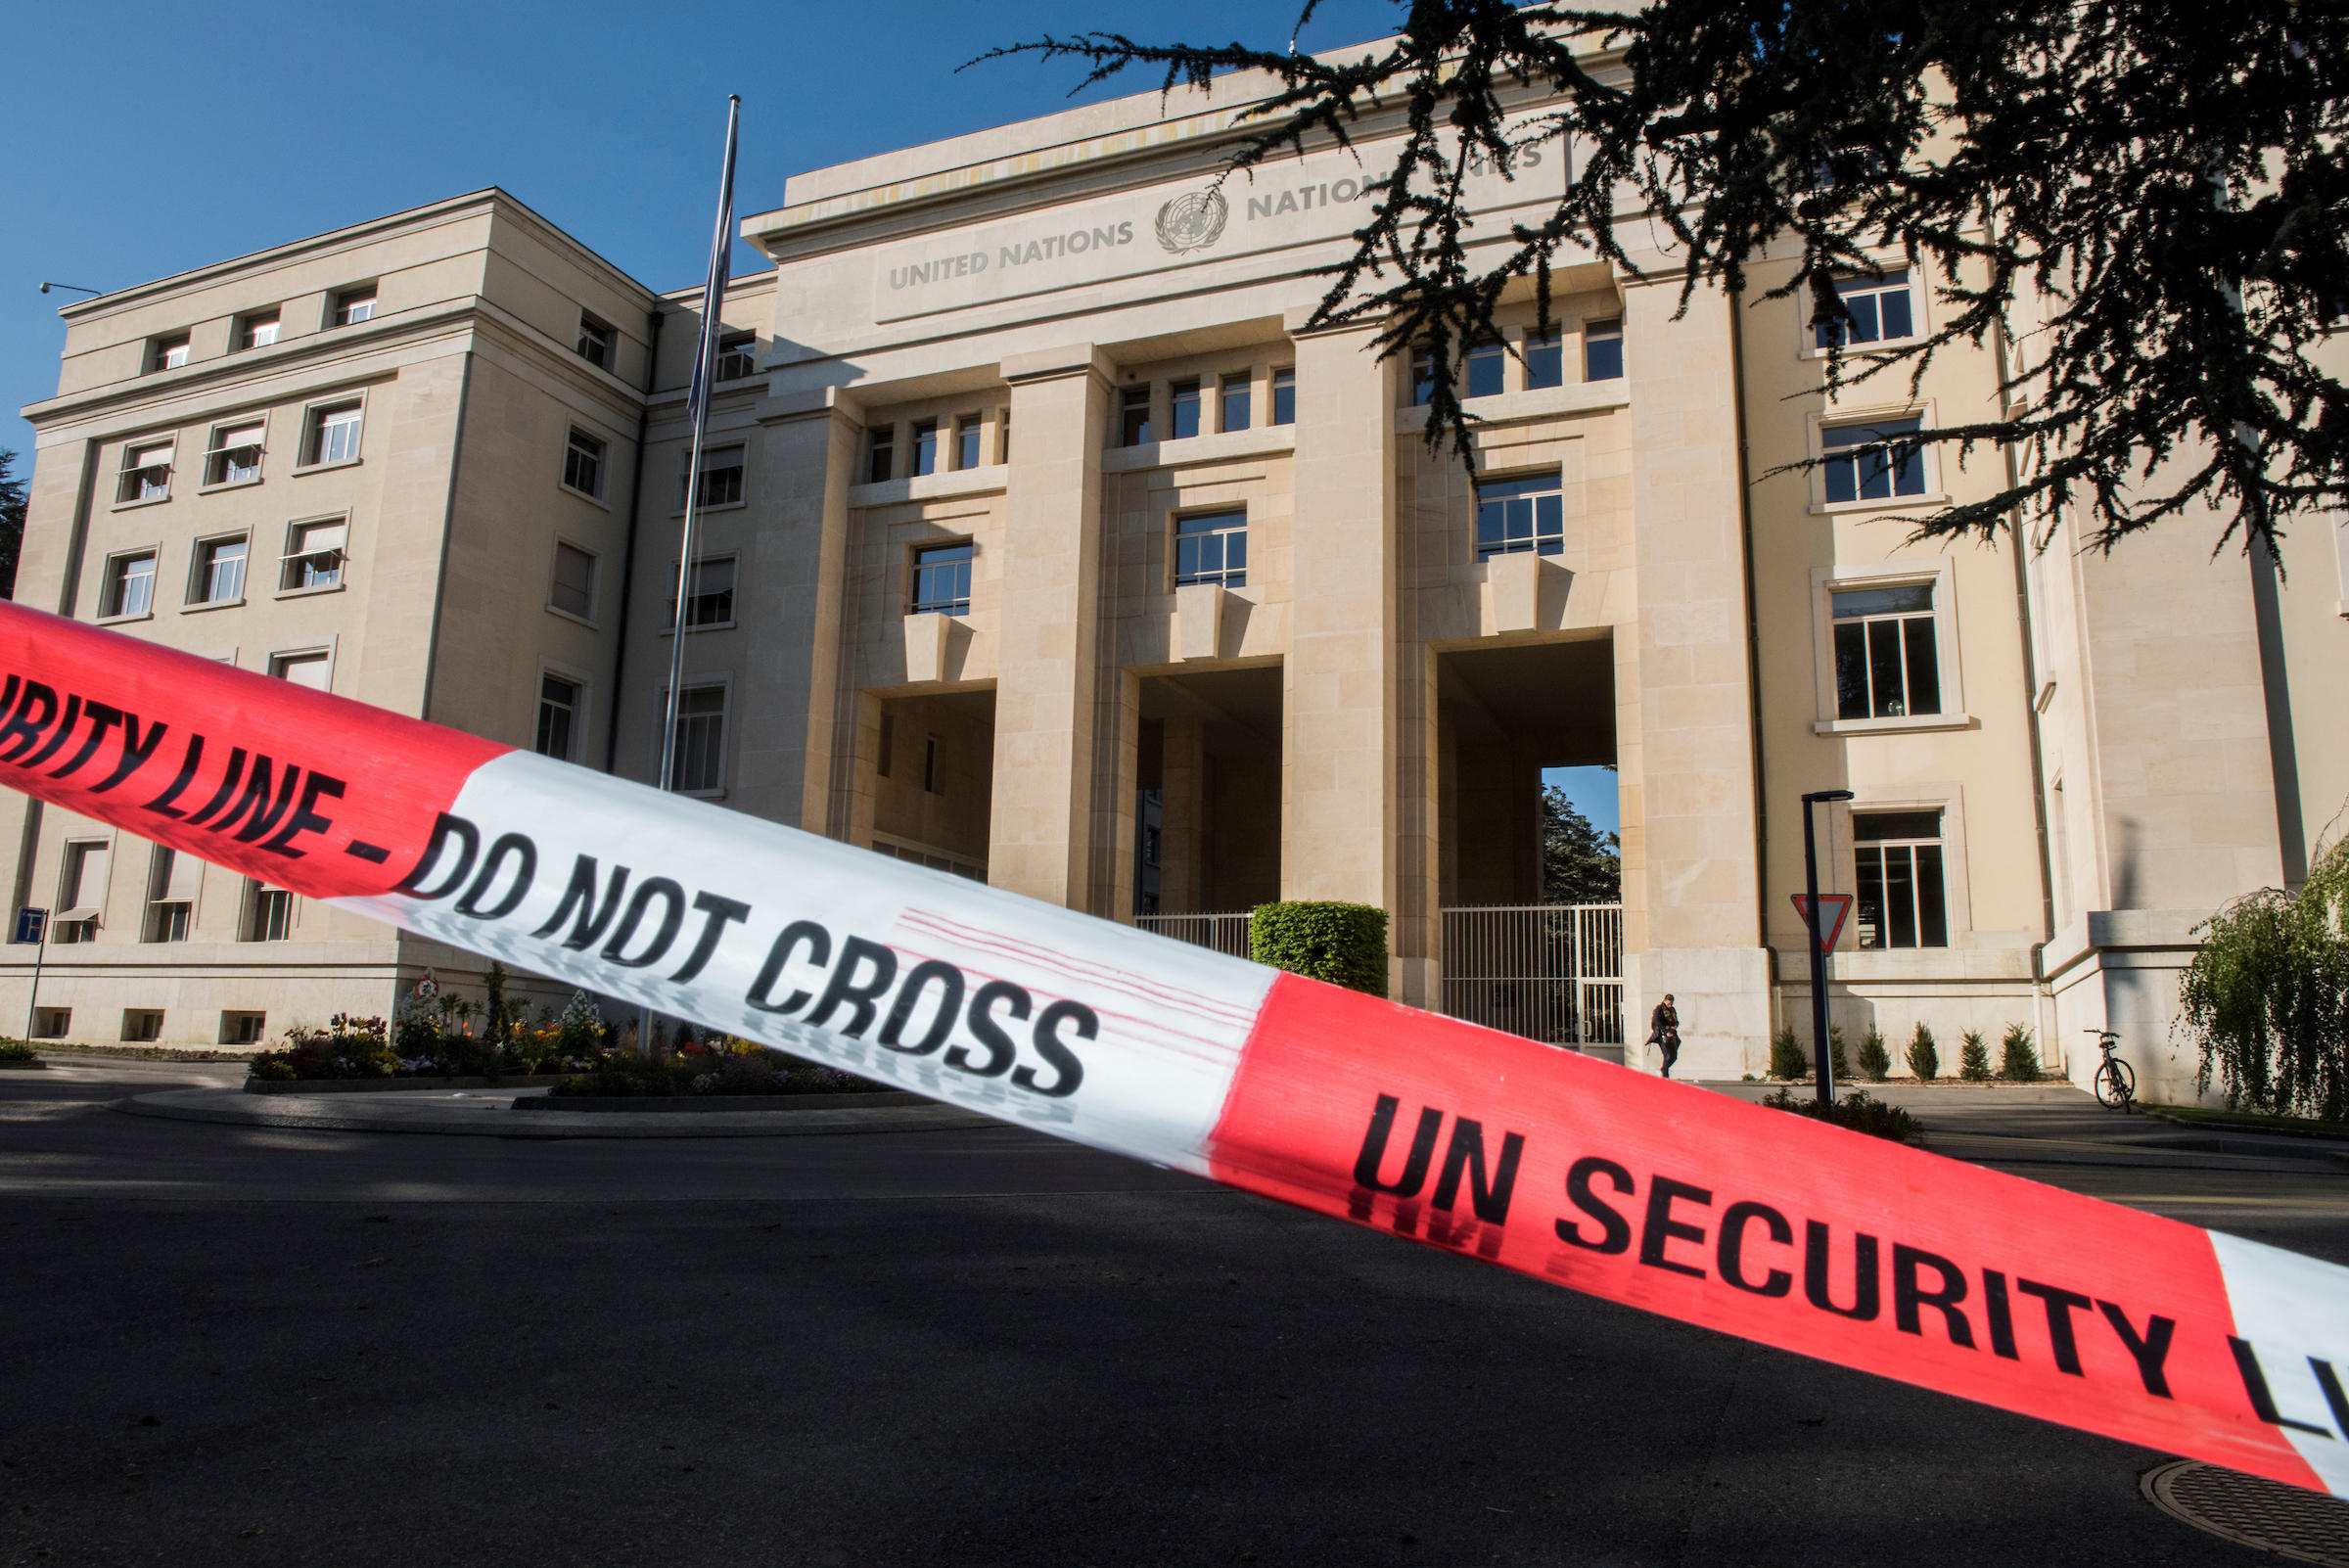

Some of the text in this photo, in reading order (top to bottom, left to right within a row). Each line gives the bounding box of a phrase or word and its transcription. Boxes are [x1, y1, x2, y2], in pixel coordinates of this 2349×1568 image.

[889, 220, 1134, 290] UNITED NATIONS
[1247, 167, 1410, 220] NATION
[143, 734, 345, 859] LINE
[392, 811, 537, 920] DO
[530, 853, 752, 985] NOT
[745, 919, 1099, 1098] CROSS
[1354, 1092, 1525, 1225] UN
[1554, 1156, 2176, 1400] SECURITY
